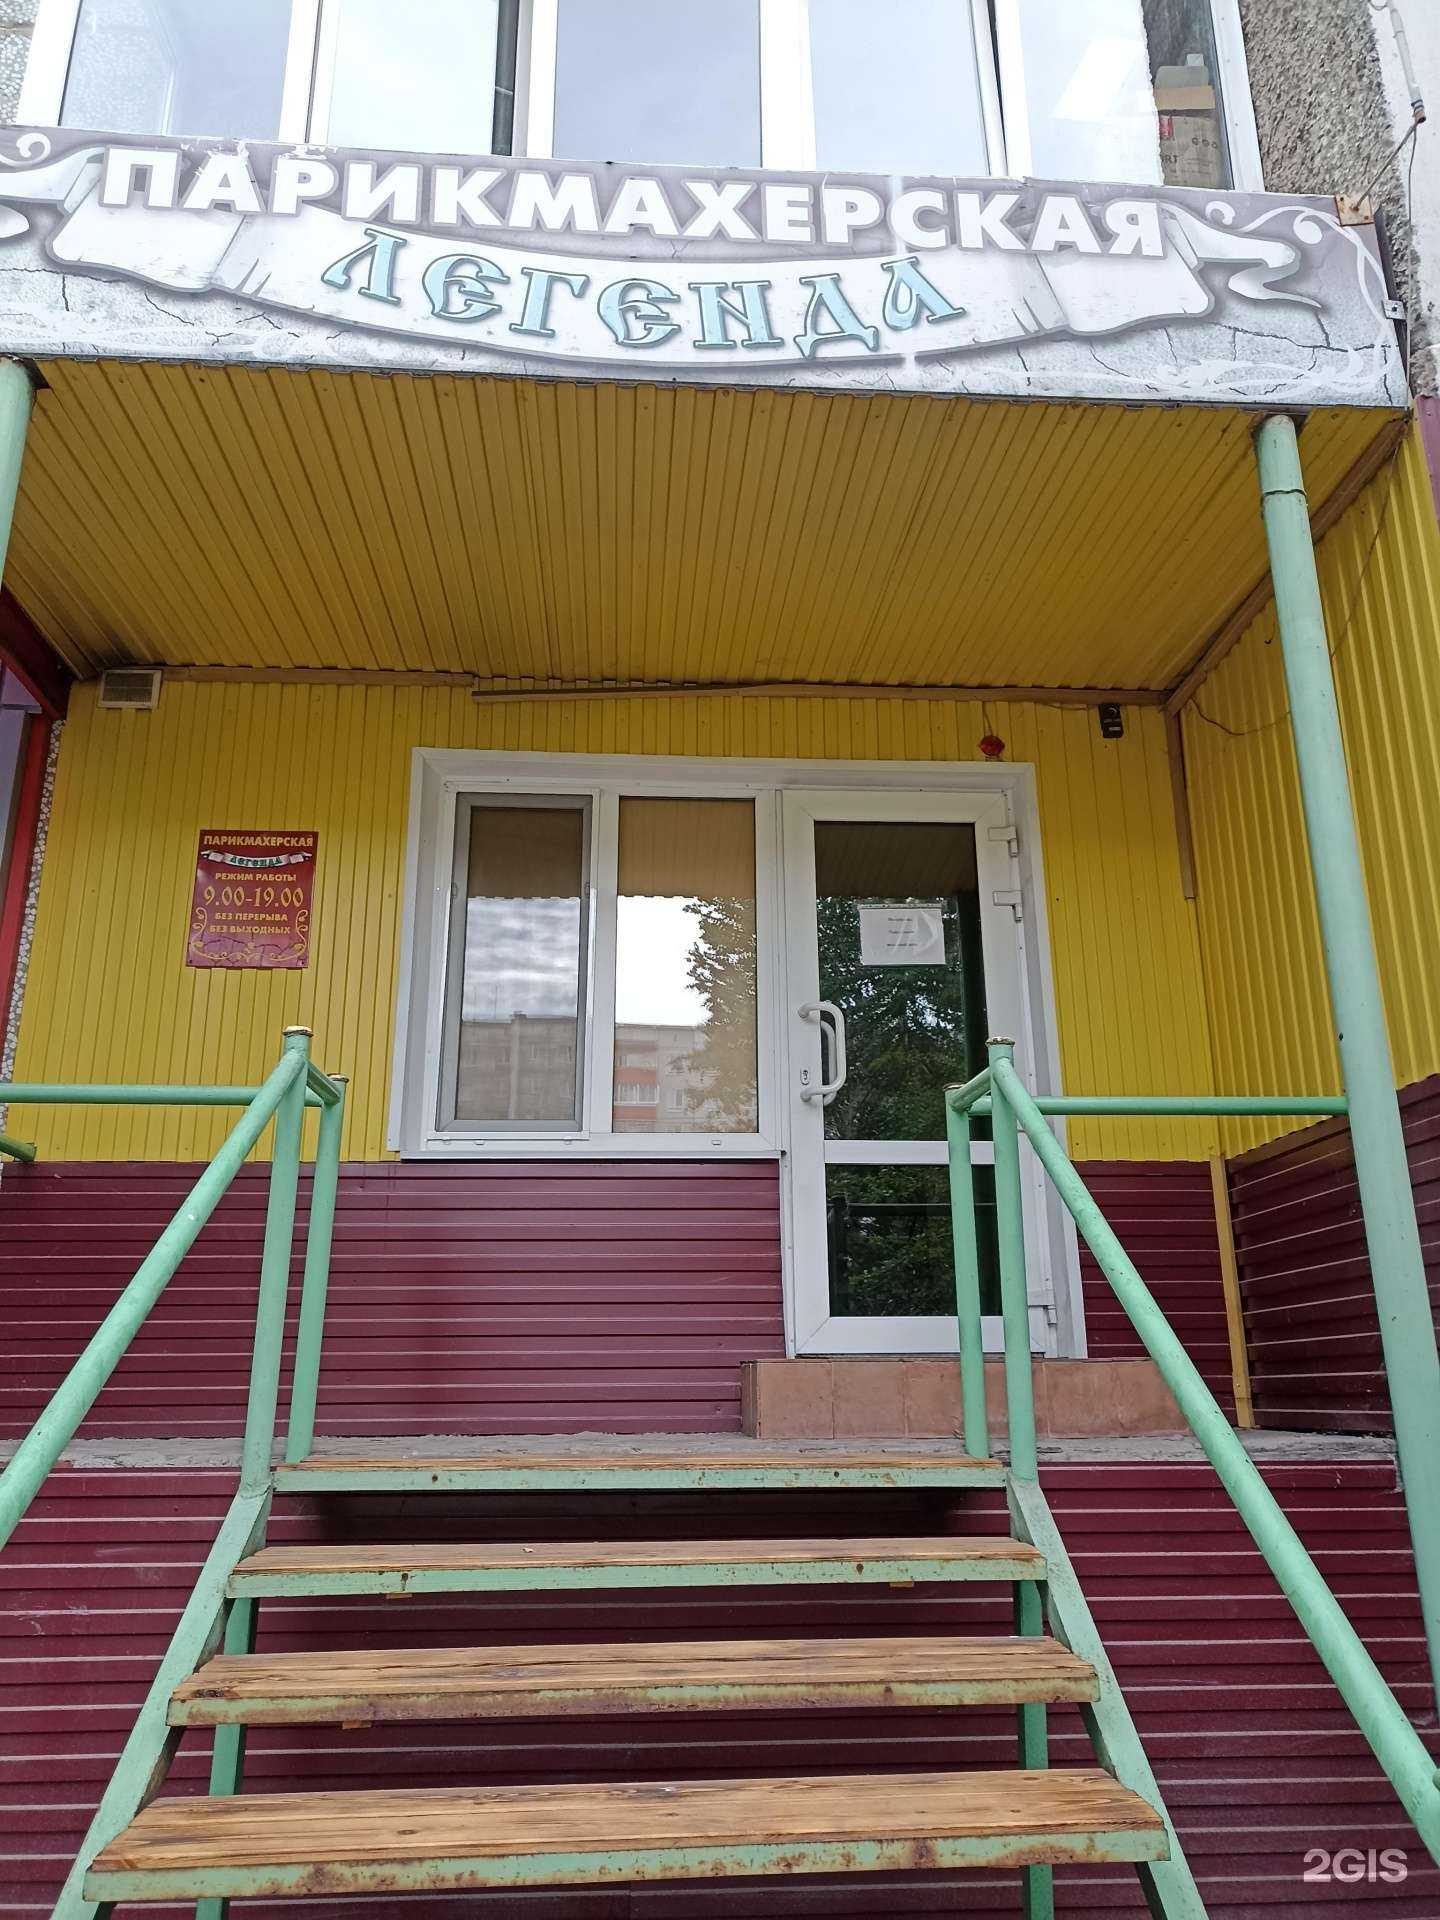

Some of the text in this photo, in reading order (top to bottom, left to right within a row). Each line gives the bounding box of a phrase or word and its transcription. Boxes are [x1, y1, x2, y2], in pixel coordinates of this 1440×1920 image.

[103, 145, 1163, 258] ПАРИКМАХЕРСКАЯ
[321, 227, 965, 359] ЛЕГЕНДА
[203, 835, 313, 847] ПАРИКМАХЕРСКАЯ
[215, 872, 297, 882] РЕЖИМ РАБОТЫ
[215, 912, 288, 921] БЕЗ ПЕРЕРЫВА
[210, 925, 291, 934] БЕЗ ВЫХОДНЫХ
